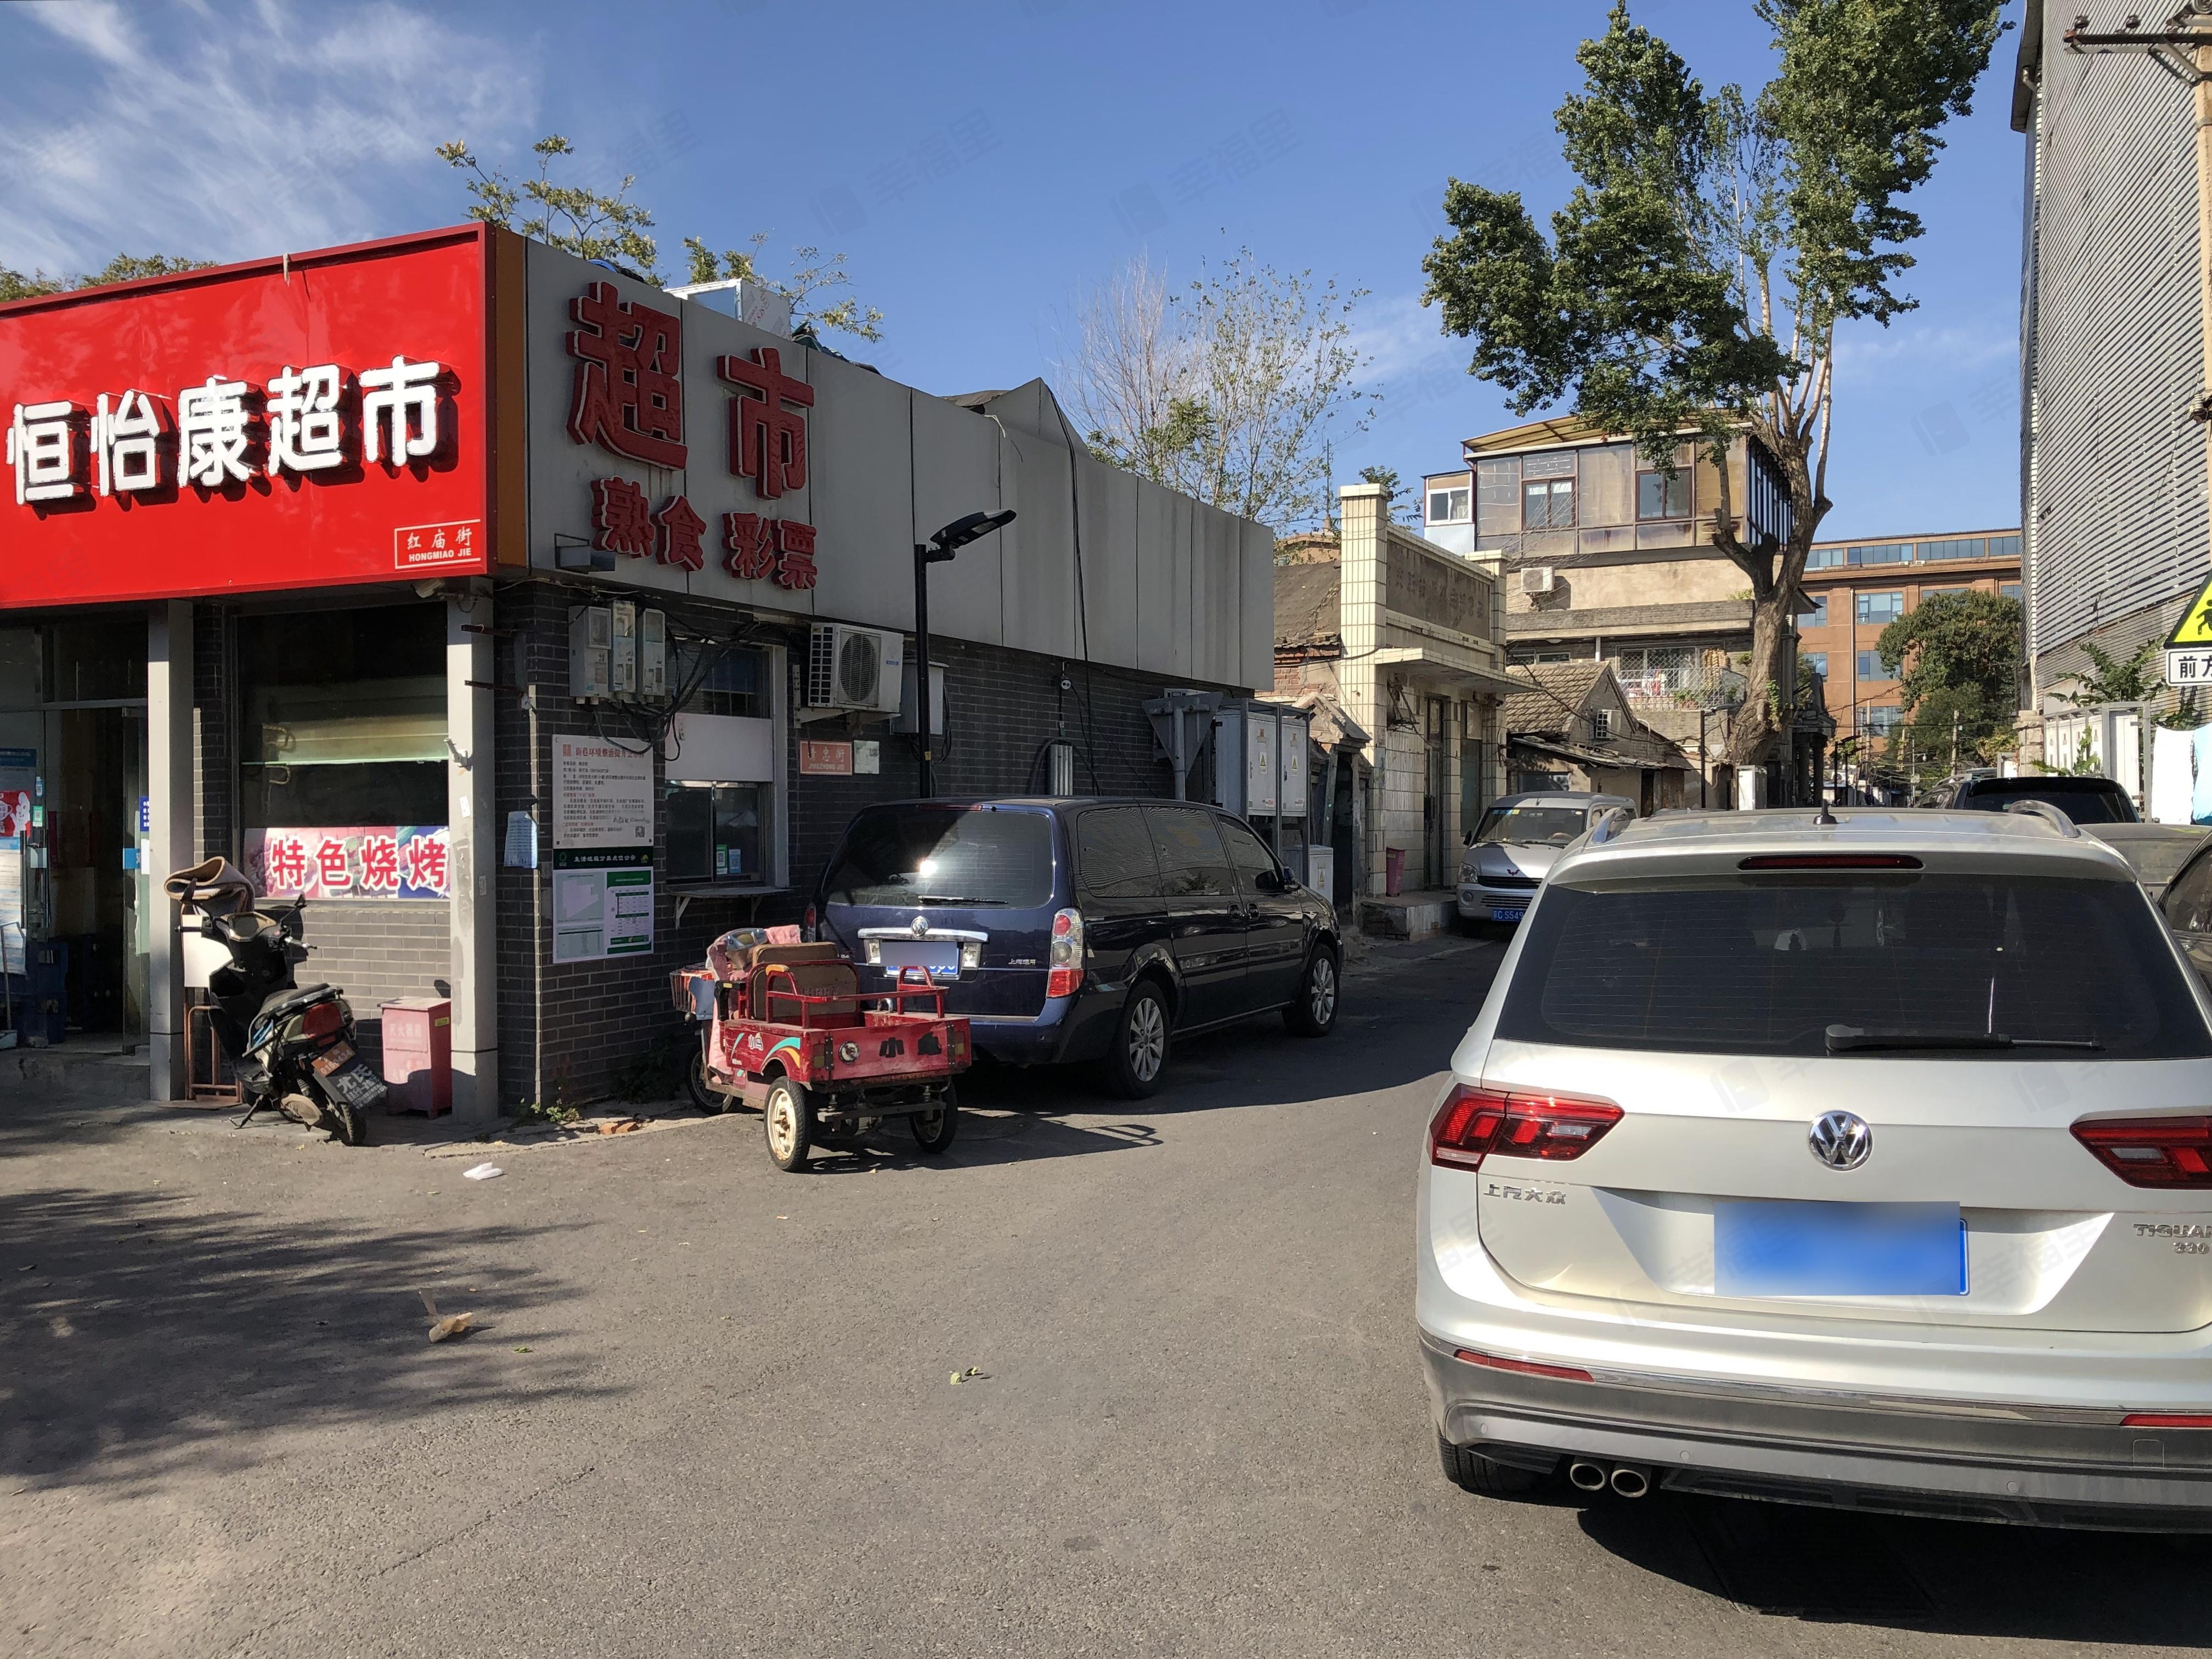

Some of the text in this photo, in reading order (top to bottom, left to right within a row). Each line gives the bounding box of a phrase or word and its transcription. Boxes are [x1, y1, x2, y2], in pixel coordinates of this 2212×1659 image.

[566, 281, 814, 500] 超市
[7, 355, 440, 505] 恒怡康超市
[407, 526, 472, 550] 红庙街
[409, 548, 472, 562] HONGMIAO JIE
[591, 476, 817, 590] 熟食 彩票
[270, 834, 447, 890] 特色烧烤
[1483, 1183, 1566, 1205] 上汽大众
